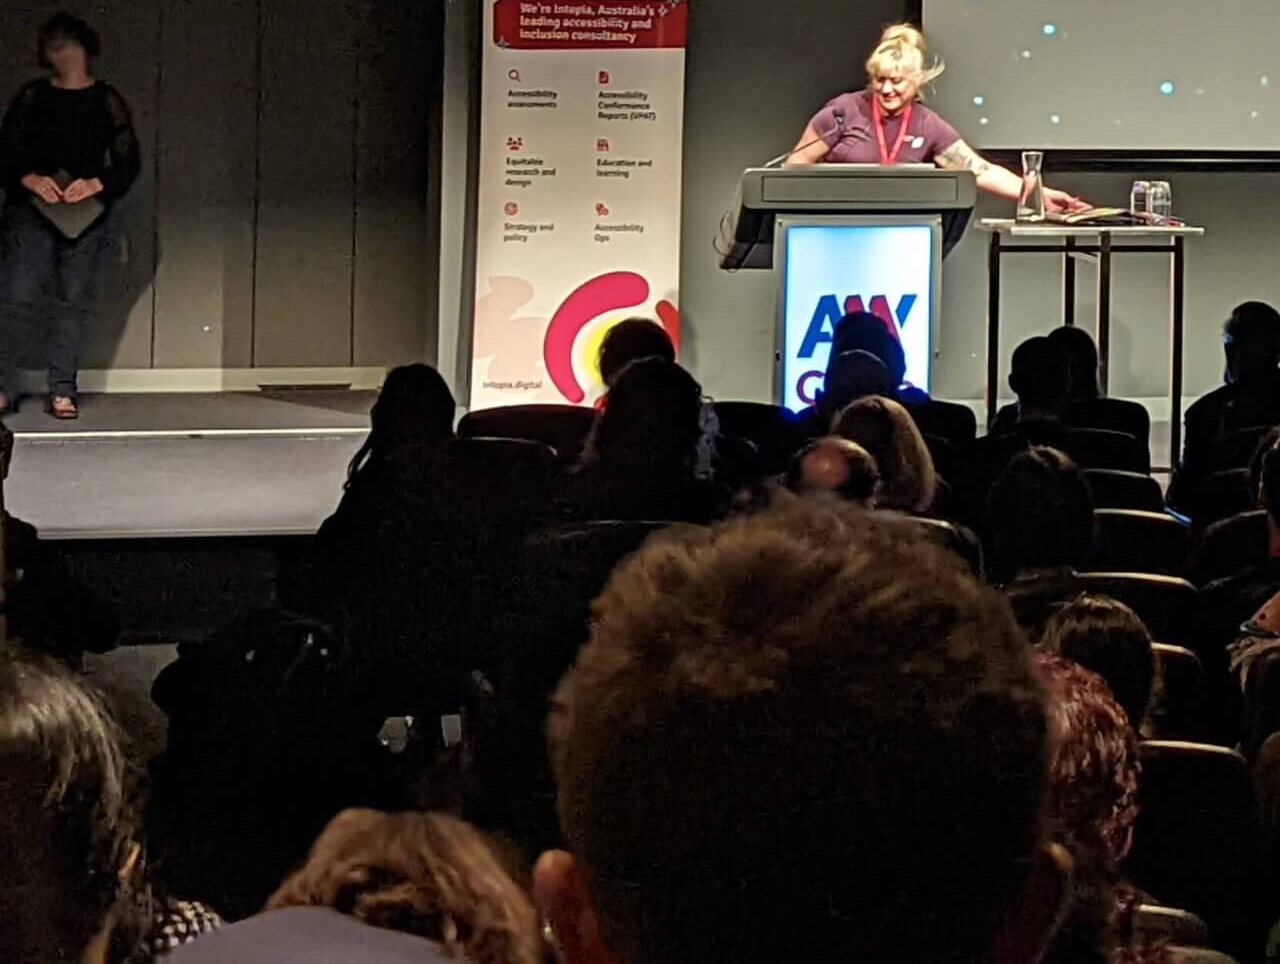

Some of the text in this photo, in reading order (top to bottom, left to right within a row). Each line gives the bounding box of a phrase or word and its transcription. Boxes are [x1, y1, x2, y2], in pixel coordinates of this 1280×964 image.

[598, 4, 655, 17] Australia's
[519, 15, 652, 31] leading accessibility and
[519, 29, 637, 44] inclusion consultancy
[504, 222, 537, 233] Strategy
